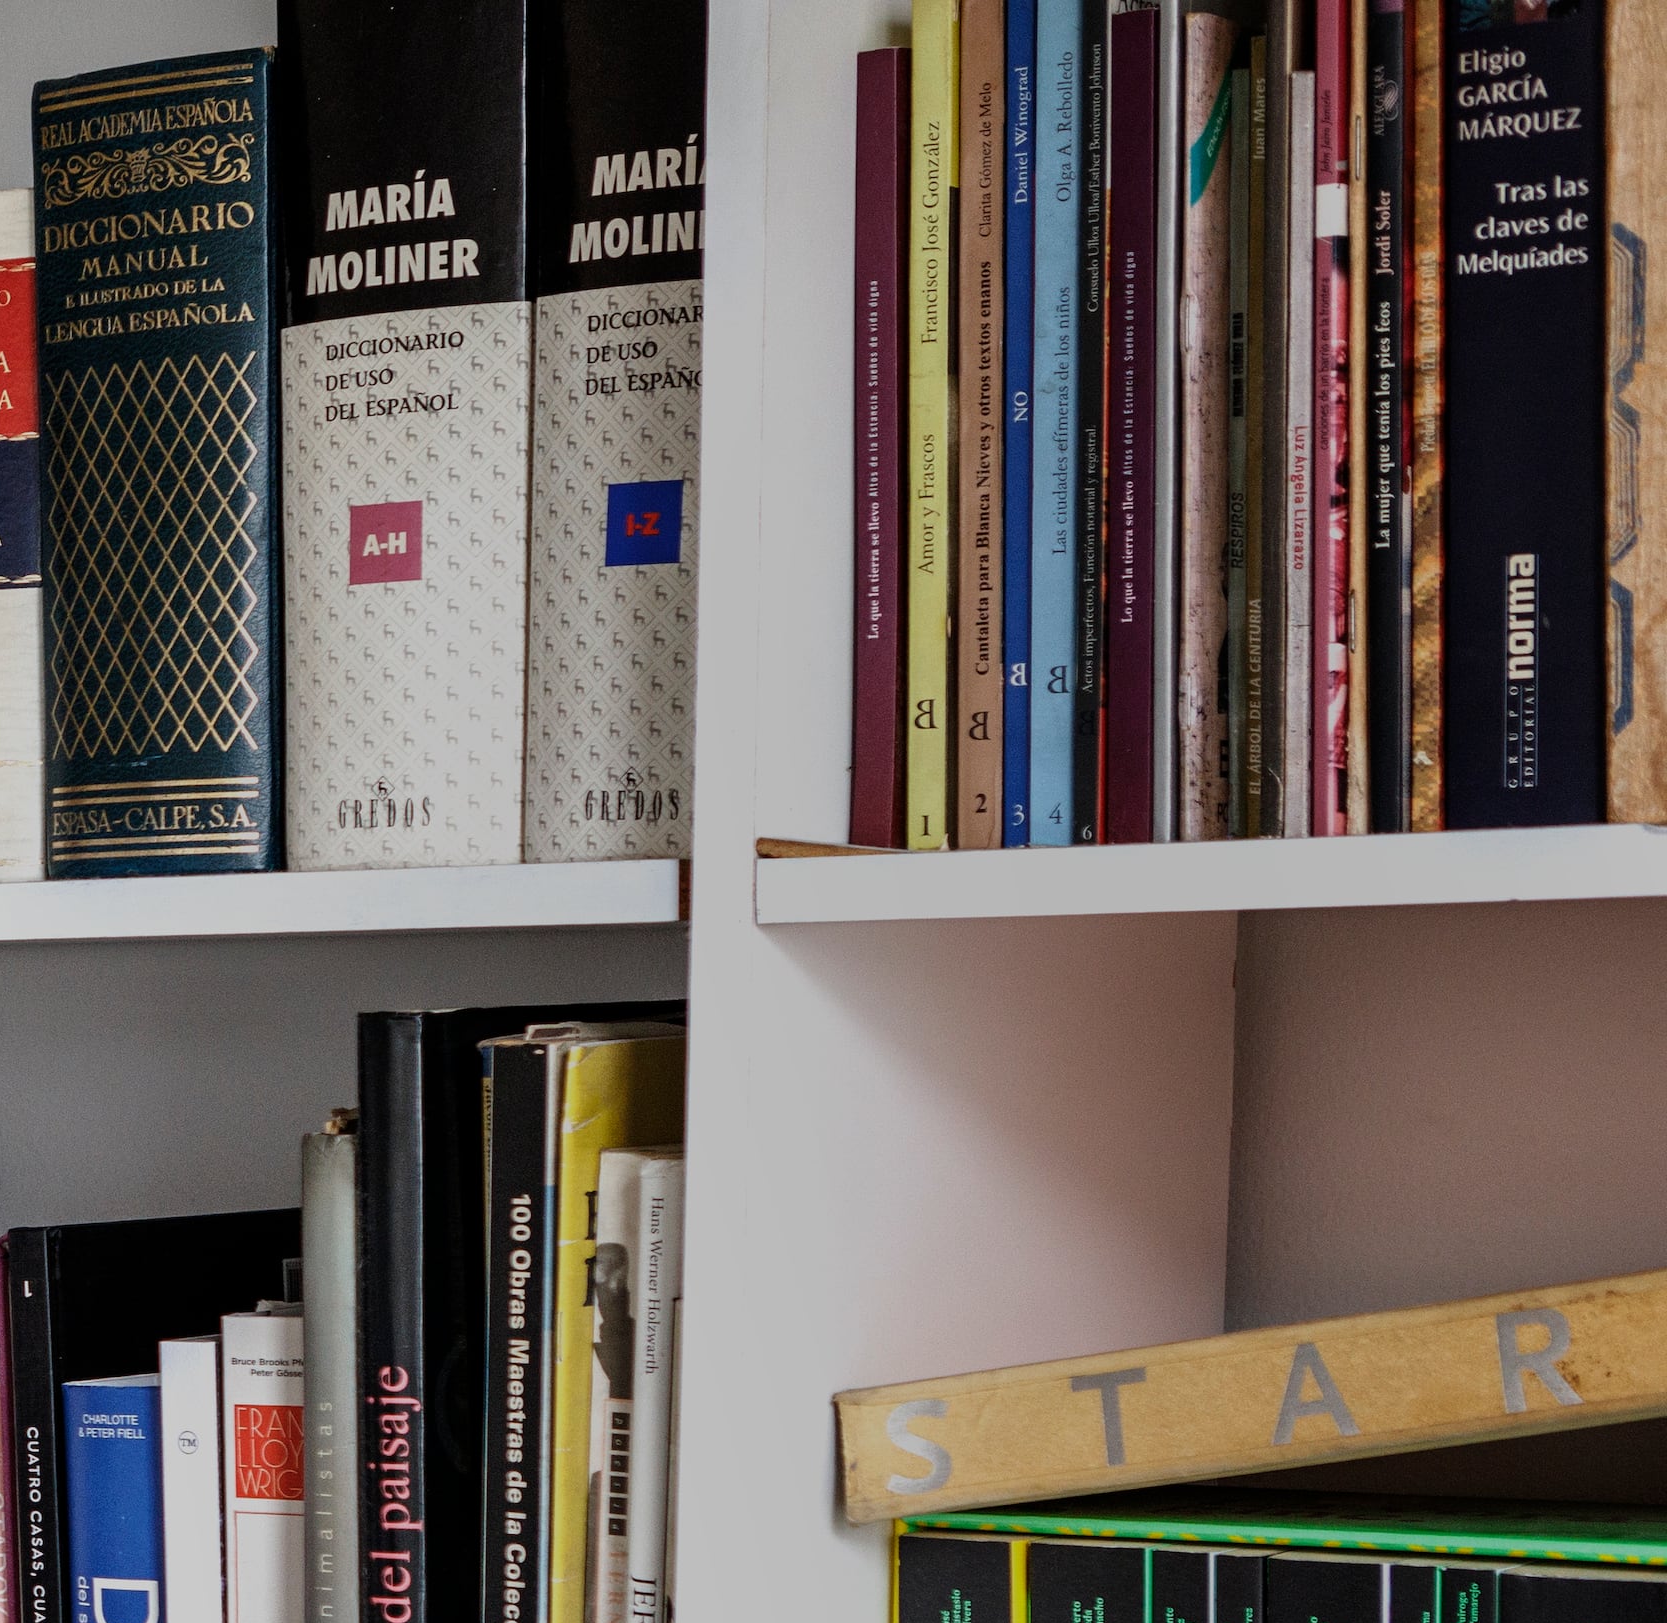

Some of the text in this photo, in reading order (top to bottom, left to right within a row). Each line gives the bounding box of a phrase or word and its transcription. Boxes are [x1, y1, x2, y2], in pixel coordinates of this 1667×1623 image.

[1458, 46, 1526, 74] Eligio
[1458, 73, 1548, 108] GARCÍA
[1014, 66, 1032, 204] Daniel Winograd
[1458, 106, 1582, 141] MÁRQUEZ
[325, 169, 455, 232] MARÍA
[1496, 175, 1589, 204] Tras las
[44, 200, 255, 254] DICCIONARIO
[921, 121, 942, 345] Francisco José González
[1476, 208, 1589, 241] claves de
[79, 247, 208, 281] MANUAL
[306, 238, 480, 295] MOLINER
[1458, 244, 1589, 277] Melquíades
[324, 329, 464, 362] DICCIONARIO
[324, 367, 394, 391] DE USO
[324, 391, 458, 422] DEL ESPAÑOL
[1013, 391, 1029, 422] NO
[626, 511, 660, 535] I-Z
[363, 530, 407, 557] A-H
[1508, 553, 1536, 680] norma
[51, 801, 258, 836] ESPASA-CALPE, S.A.
[338, 797, 433, 828] GREDOS
[509, 1195, 532, 1241] 100
[508, 1250, 532, 1330] Obras
[506, 1339, 530, 1464] Maestras
[26, 1426, 43, 1504] CUATRO
[367, 1365, 424, 1533] paisaje
[505, 1470, 528, 1504] de
[504, 1510, 524, 1536] la
[28, 1509, 46, 1577] CASAS,
